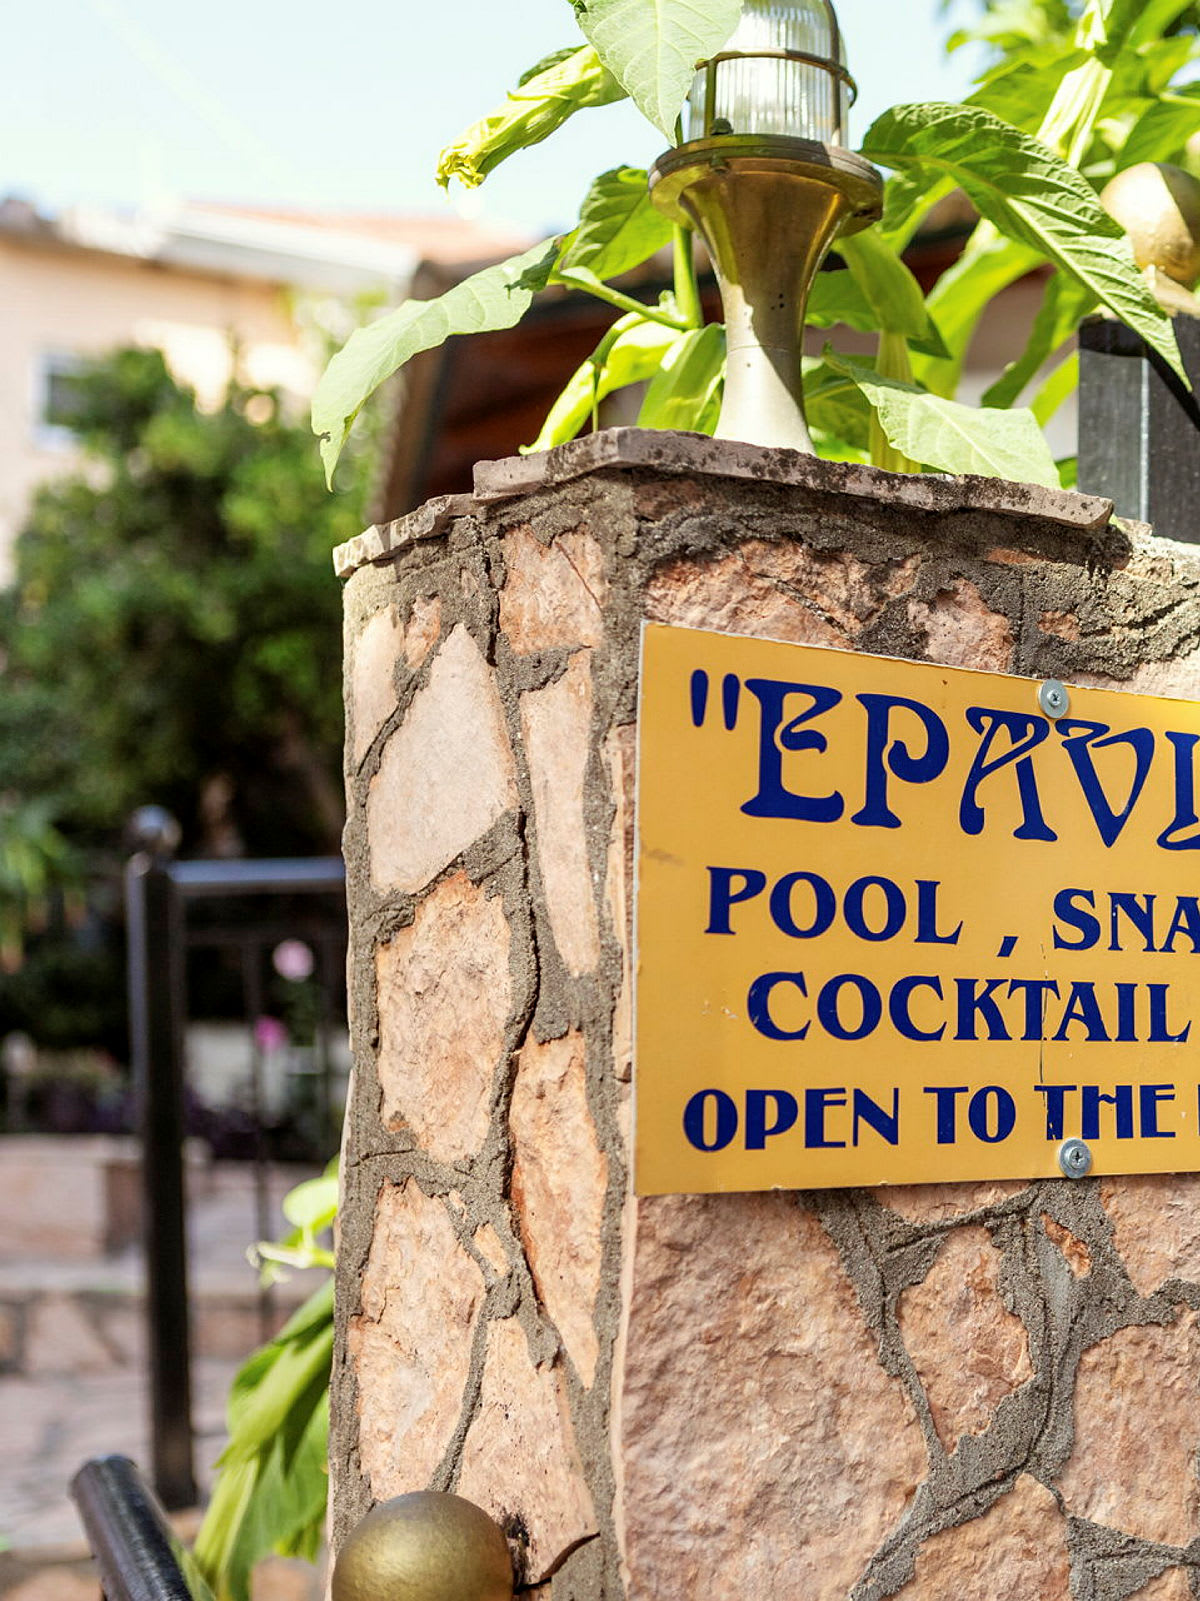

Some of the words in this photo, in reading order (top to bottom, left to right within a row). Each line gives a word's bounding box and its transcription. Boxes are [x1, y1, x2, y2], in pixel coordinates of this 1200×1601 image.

[706, 866, 962, 943] POOL
[747, 971, 1189, 1043] COCKTAIL
[683, 1087, 899, 1151] OPEN
[923, 1085, 1016, 1144] TO
[1034, 1084, 1176, 1141] THE
